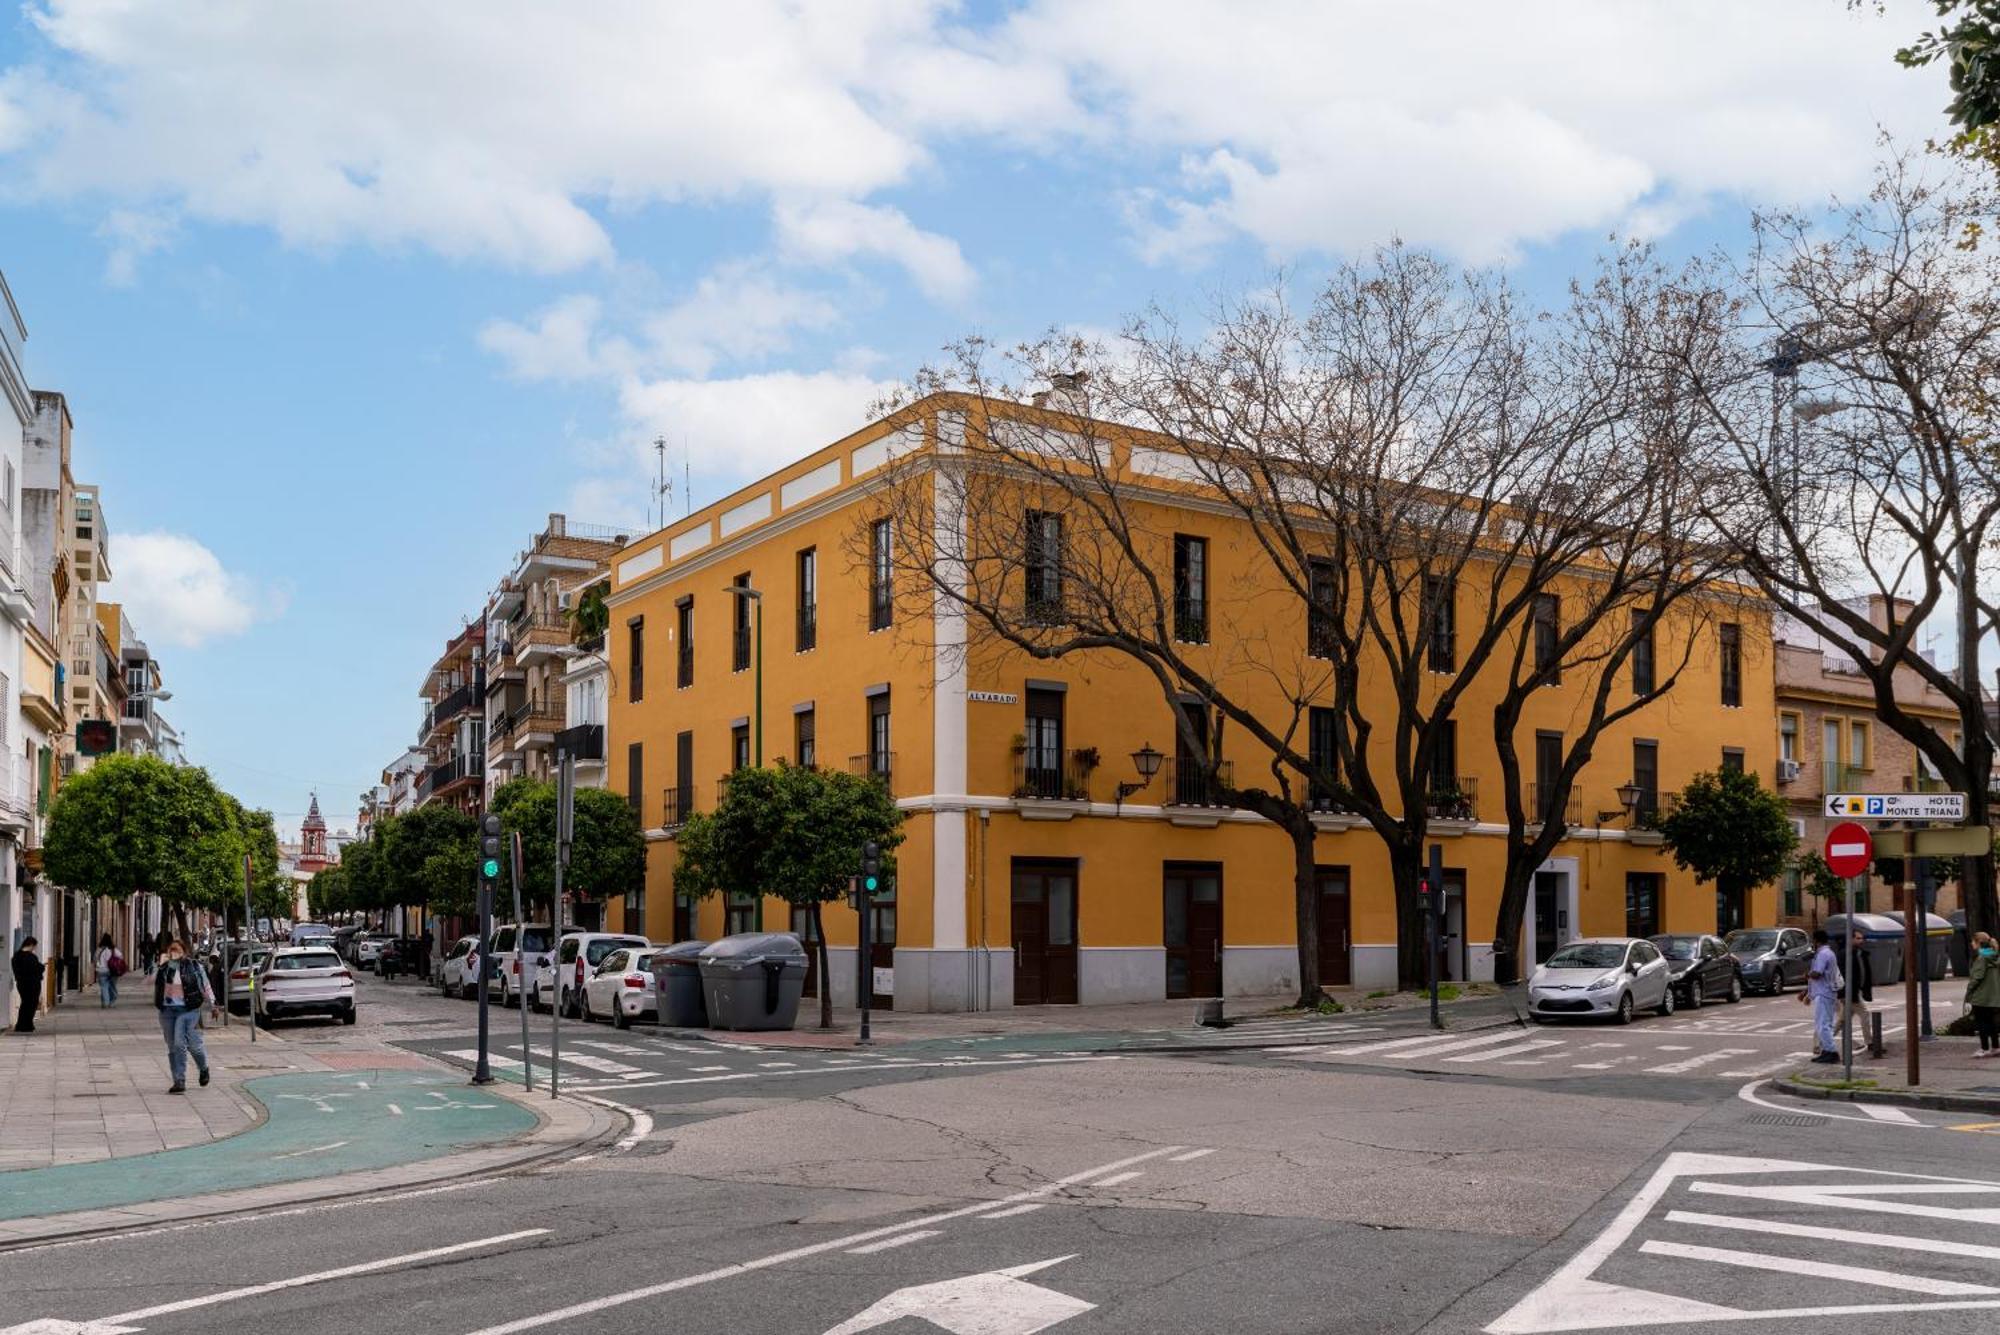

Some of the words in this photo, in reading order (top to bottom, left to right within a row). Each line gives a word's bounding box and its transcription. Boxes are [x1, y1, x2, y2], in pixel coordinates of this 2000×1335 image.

[1928, 797, 1961, 805] HOTEL
[1886, 807, 1920, 816] MONTE
[1924, 807, 1961, 816] TRIANA
